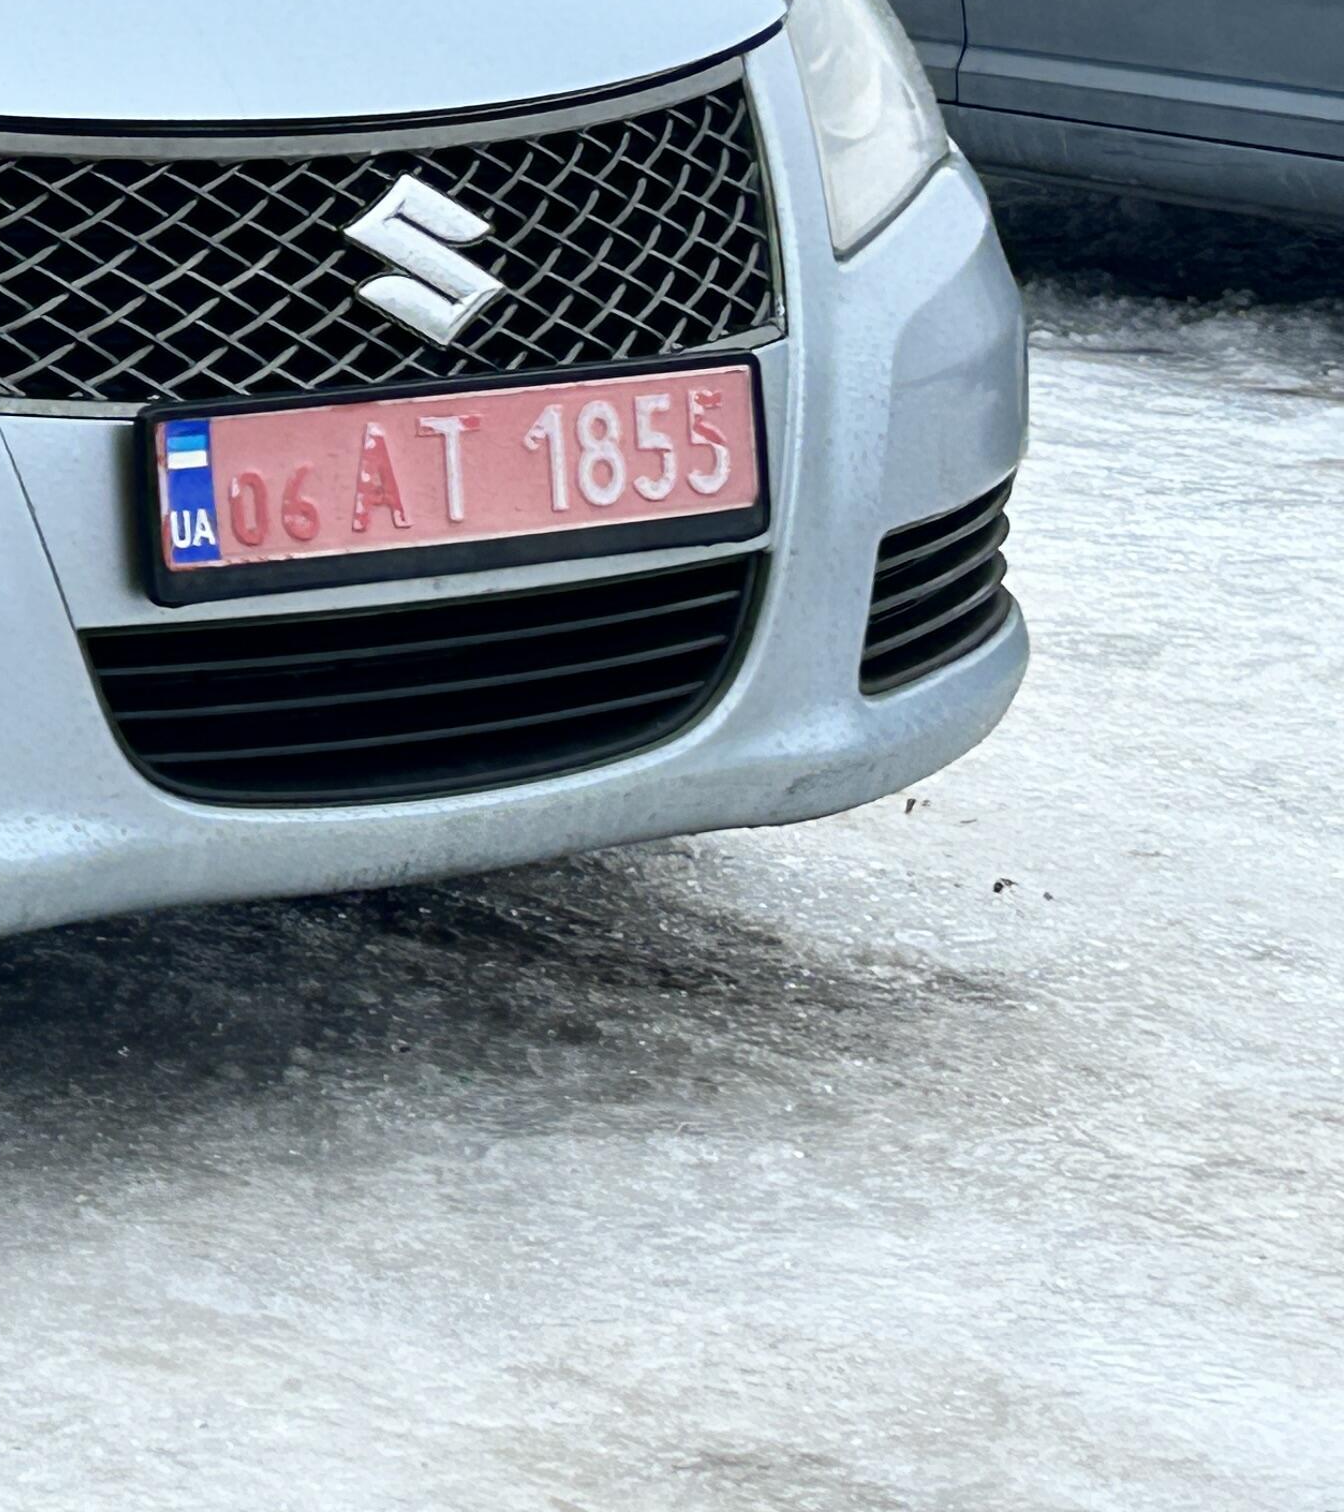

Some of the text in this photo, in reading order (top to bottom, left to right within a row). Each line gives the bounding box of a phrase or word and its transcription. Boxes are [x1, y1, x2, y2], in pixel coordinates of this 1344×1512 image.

[229, 387, 731, 546] 06 AT 1855
[170, 508, 216, 549] UA
